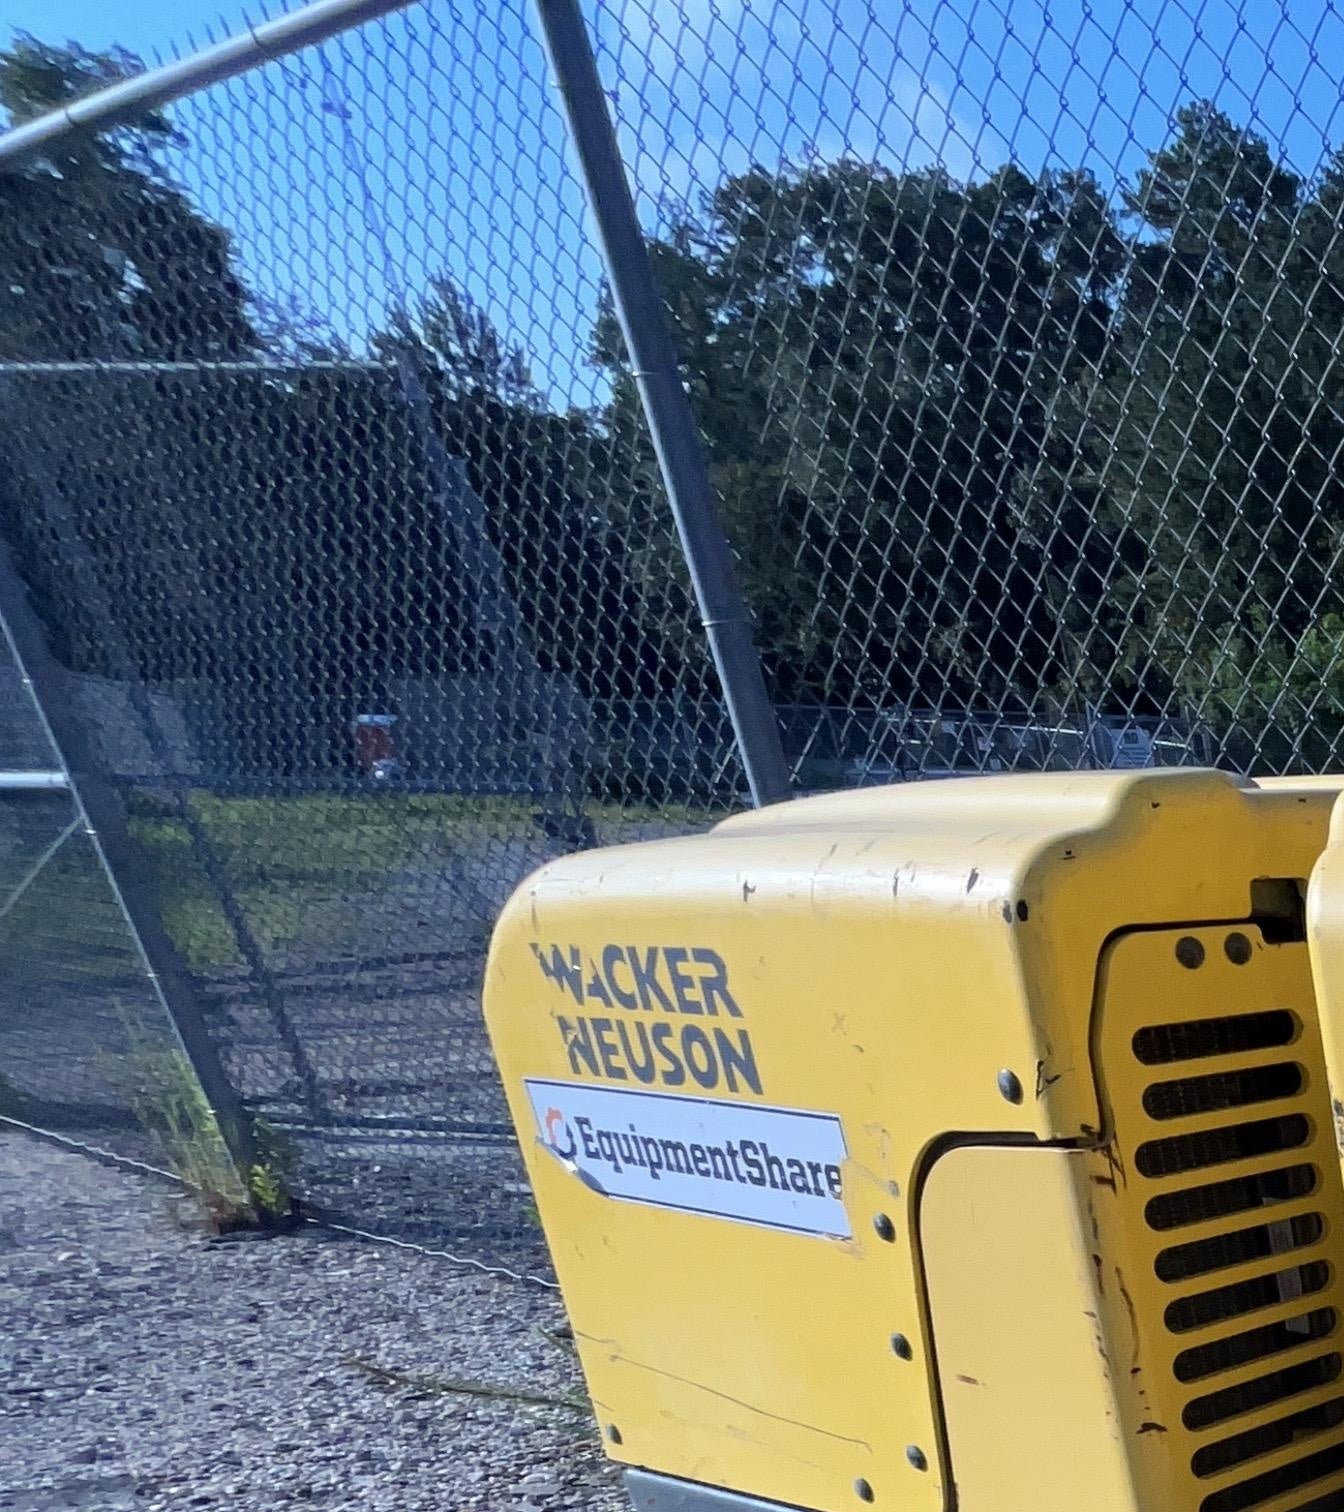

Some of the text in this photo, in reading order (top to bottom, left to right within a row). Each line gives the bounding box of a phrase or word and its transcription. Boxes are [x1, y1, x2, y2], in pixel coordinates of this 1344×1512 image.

[529, 942, 745, 1019] WACKER
[556, 1014, 764, 1096] NEUSON
[574, 1115, 842, 1201] EquipmentShare
